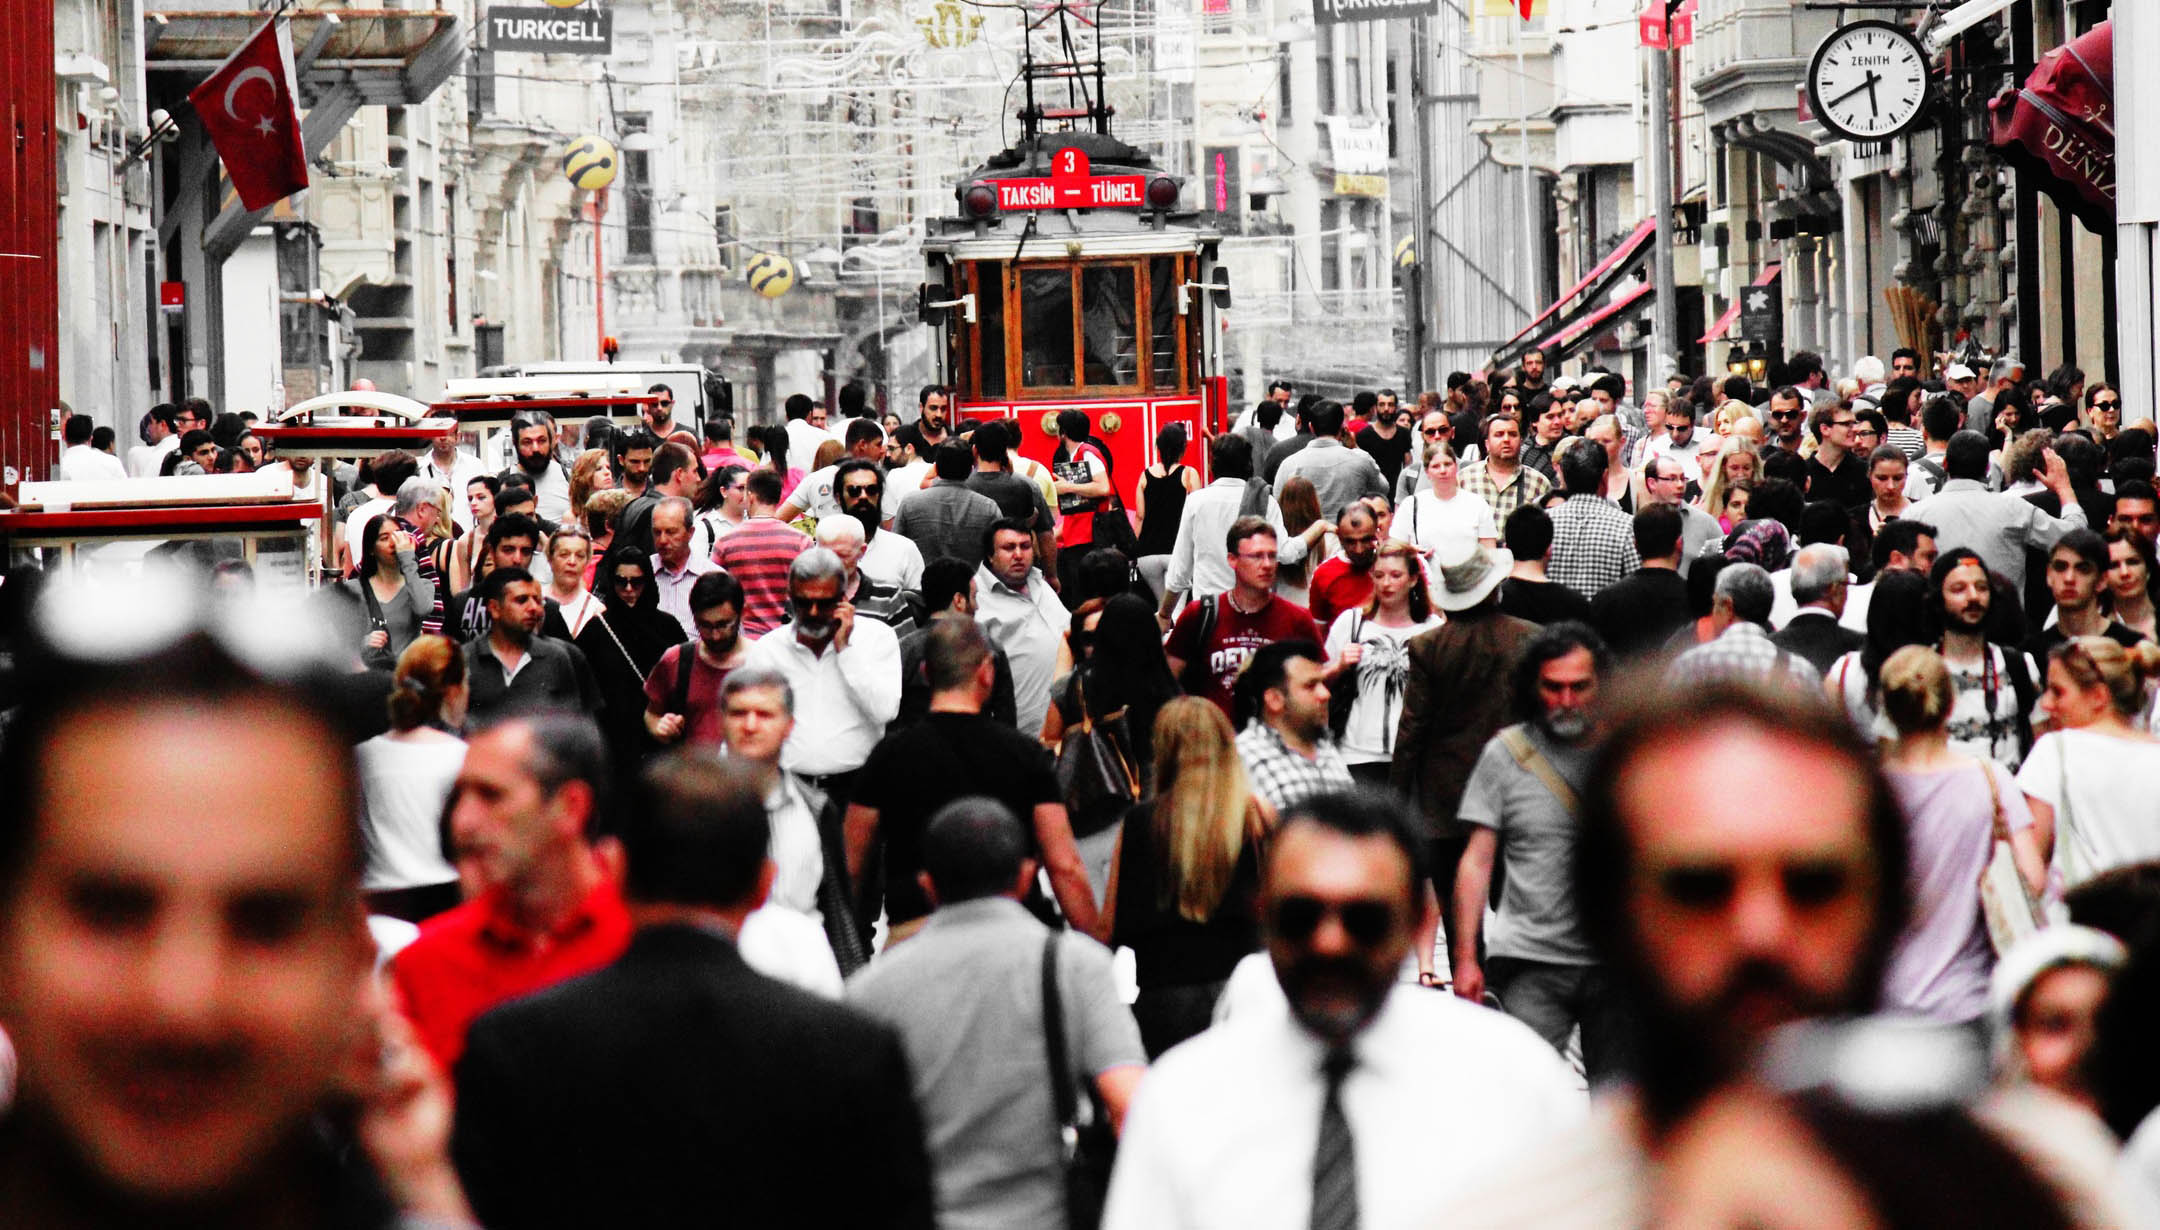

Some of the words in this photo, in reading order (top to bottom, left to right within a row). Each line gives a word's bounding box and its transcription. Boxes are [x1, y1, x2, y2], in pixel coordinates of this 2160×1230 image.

[494, 18, 605, 41] TURKCELL
[1851, 55, 1890, 66] ZENITH
[1064, 151, 1075, 173] 3
[1091, 180, 1142, 203] TÜNEL
